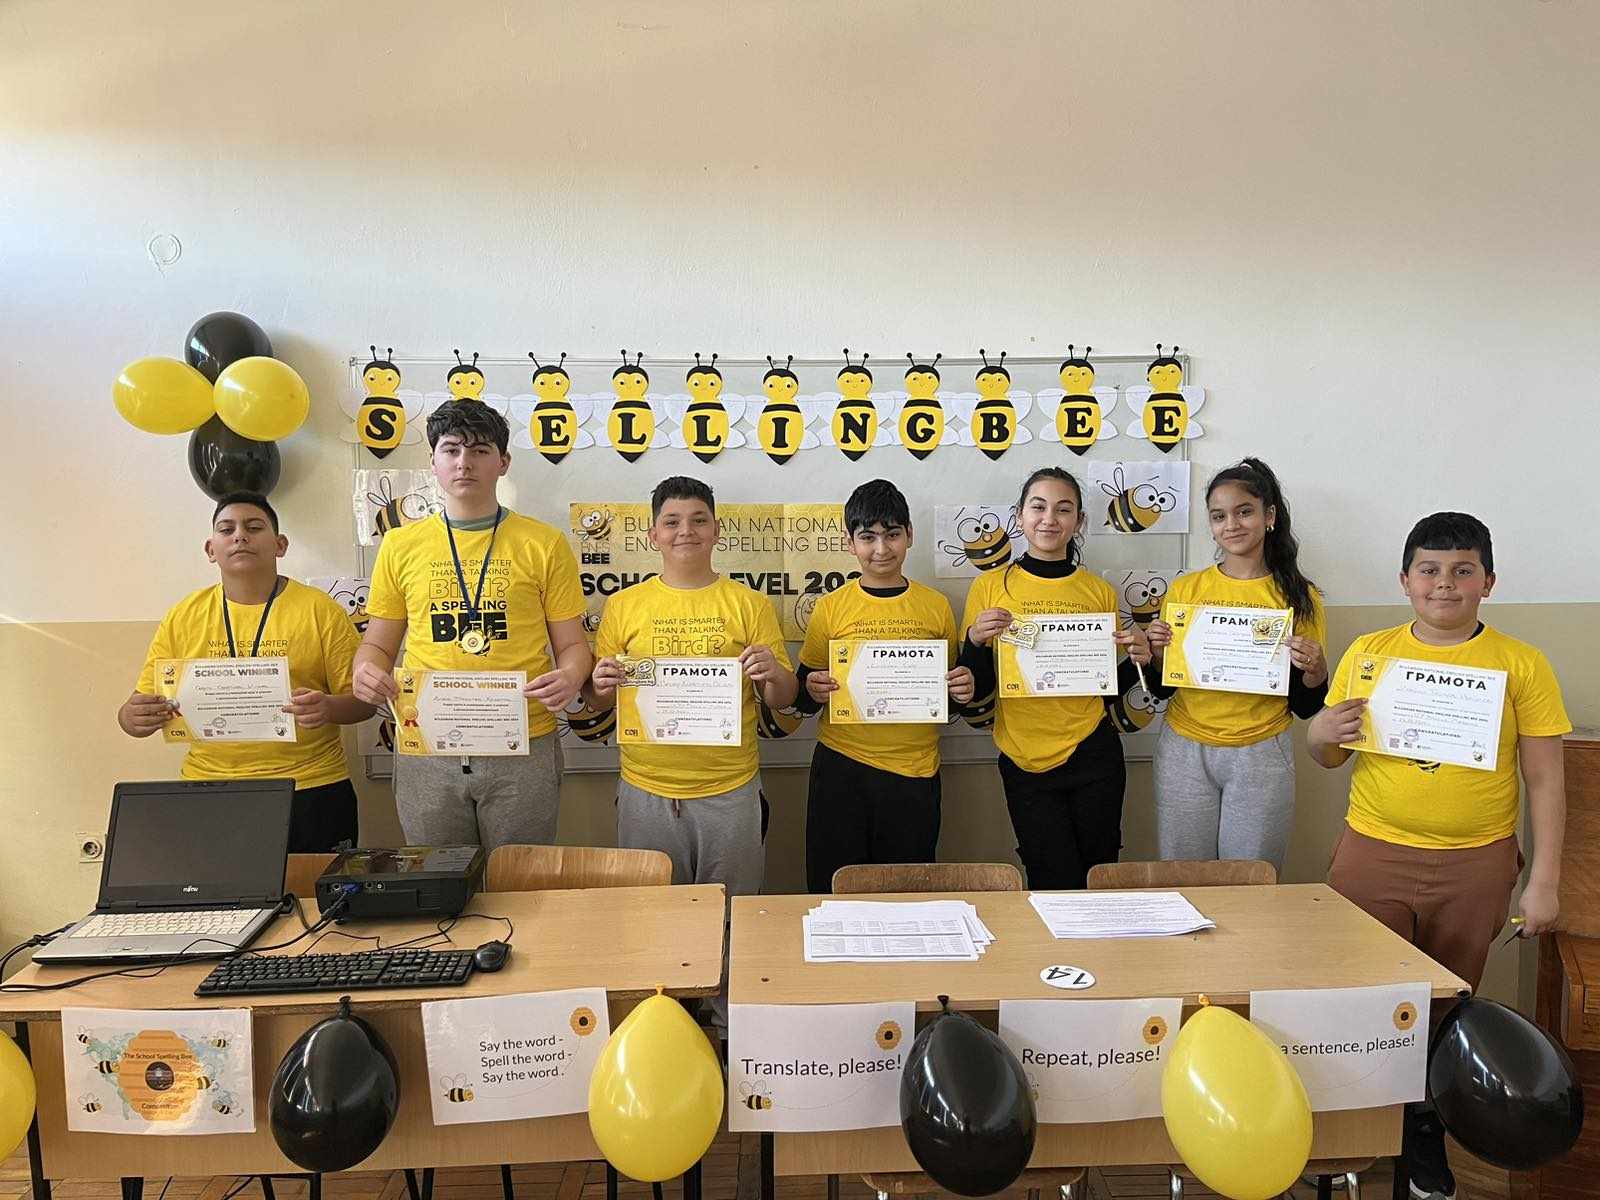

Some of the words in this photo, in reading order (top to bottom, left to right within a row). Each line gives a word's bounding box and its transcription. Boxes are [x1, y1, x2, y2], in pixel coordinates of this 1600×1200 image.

[749, 516, 847, 533] NATIONAL
[716, 536, 810, 552] SPELLING
[817, 536, 849, 552] BEE
[430, 560, 453, 568] WHA
[581, 553, 610, 565] BEE
[469, 568, 510, 576] TAKING
[580, 572, 659, 596] SCH
[430, 602, 439, 612] A
[441, 600, 507, 611] SPELING
[431, 613, 508, 642] BEE
[1041, 623, 1103, 632] ГРАМОТА
[208, 640, 229, 648] WHA
[246, 640, 289, 648] SARTER
[652, 635, 726, 656] Bird?
[209, 650, 230, 658] THA
[247, 649, 287, 657] TLKING
[873, 650, 934, 658] ГРАМОТА
[663, 667, 728, 677] ГРАМОТА
[433, 681, 474, 689] SCHOOL
[477, 682, 518, 690] WINNER
[1406, 671, 1487, 690] ГРАМОТА
[479, 1041, 501, 1053] Say
[503, 1038, 523, 1050] the
[524, 1035, 556, 1048] word
[1292, 1042, 1363, 1055] sentence,
[1366, 1034, 1415, 1054] please!
[481, 1056, 510, 1069] Spell
[512, 1053, 532, 1065] the
[533, 1050, 565, 1062] word
[1022, 1048, 1093, 1068] Repeat,
[1097, 1046, 1161, 1068] please!
[741, 1058, 834, 1077] Translate,
[838, 1054, 901, 1077] please!
[482, 1072, 504, 1084] Say
[506, 1069, 525, 1081] the
[527, 1066, 559, 1078] word
